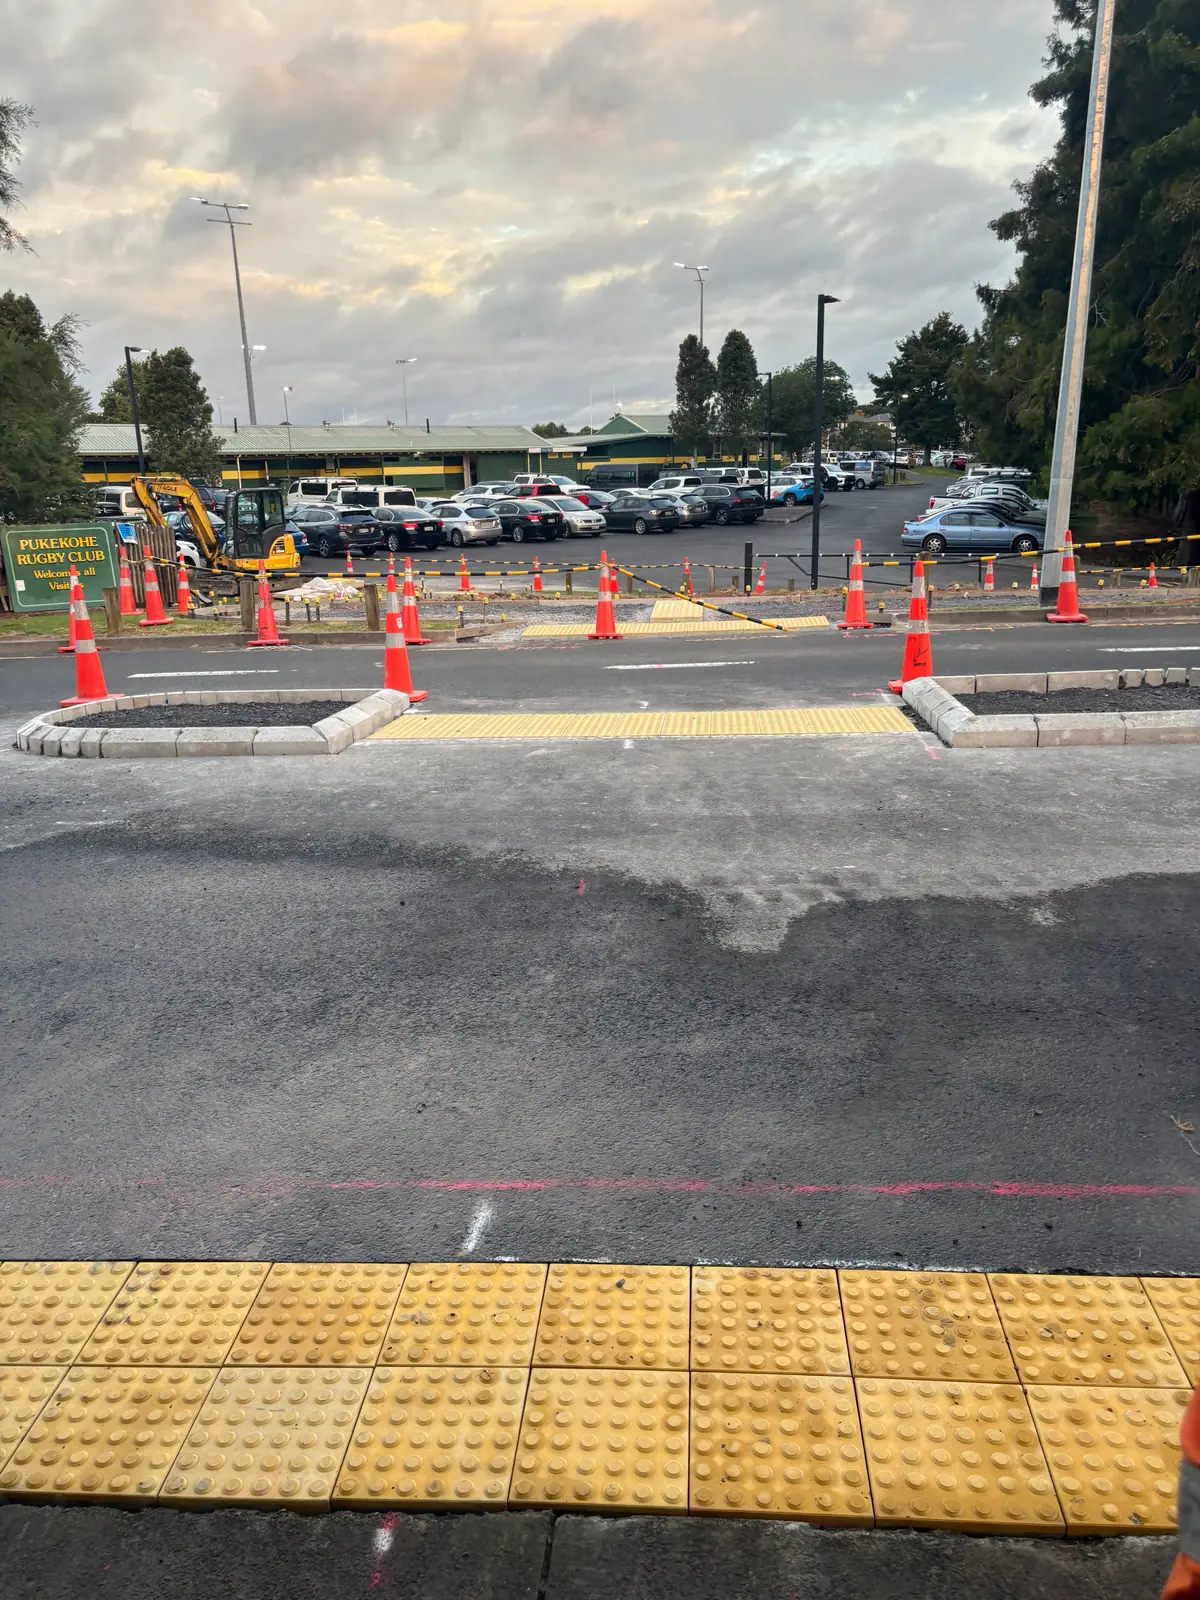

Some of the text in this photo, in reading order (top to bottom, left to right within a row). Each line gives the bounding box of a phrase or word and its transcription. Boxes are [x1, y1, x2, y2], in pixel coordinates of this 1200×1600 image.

[19, 536, 99, 550] PUKEKOHE
[16, 550, 106, 566] RUGBY CLUB
[33, 567, 96, 579] Welcoms all
[48, 581, 84, 591] Visits
